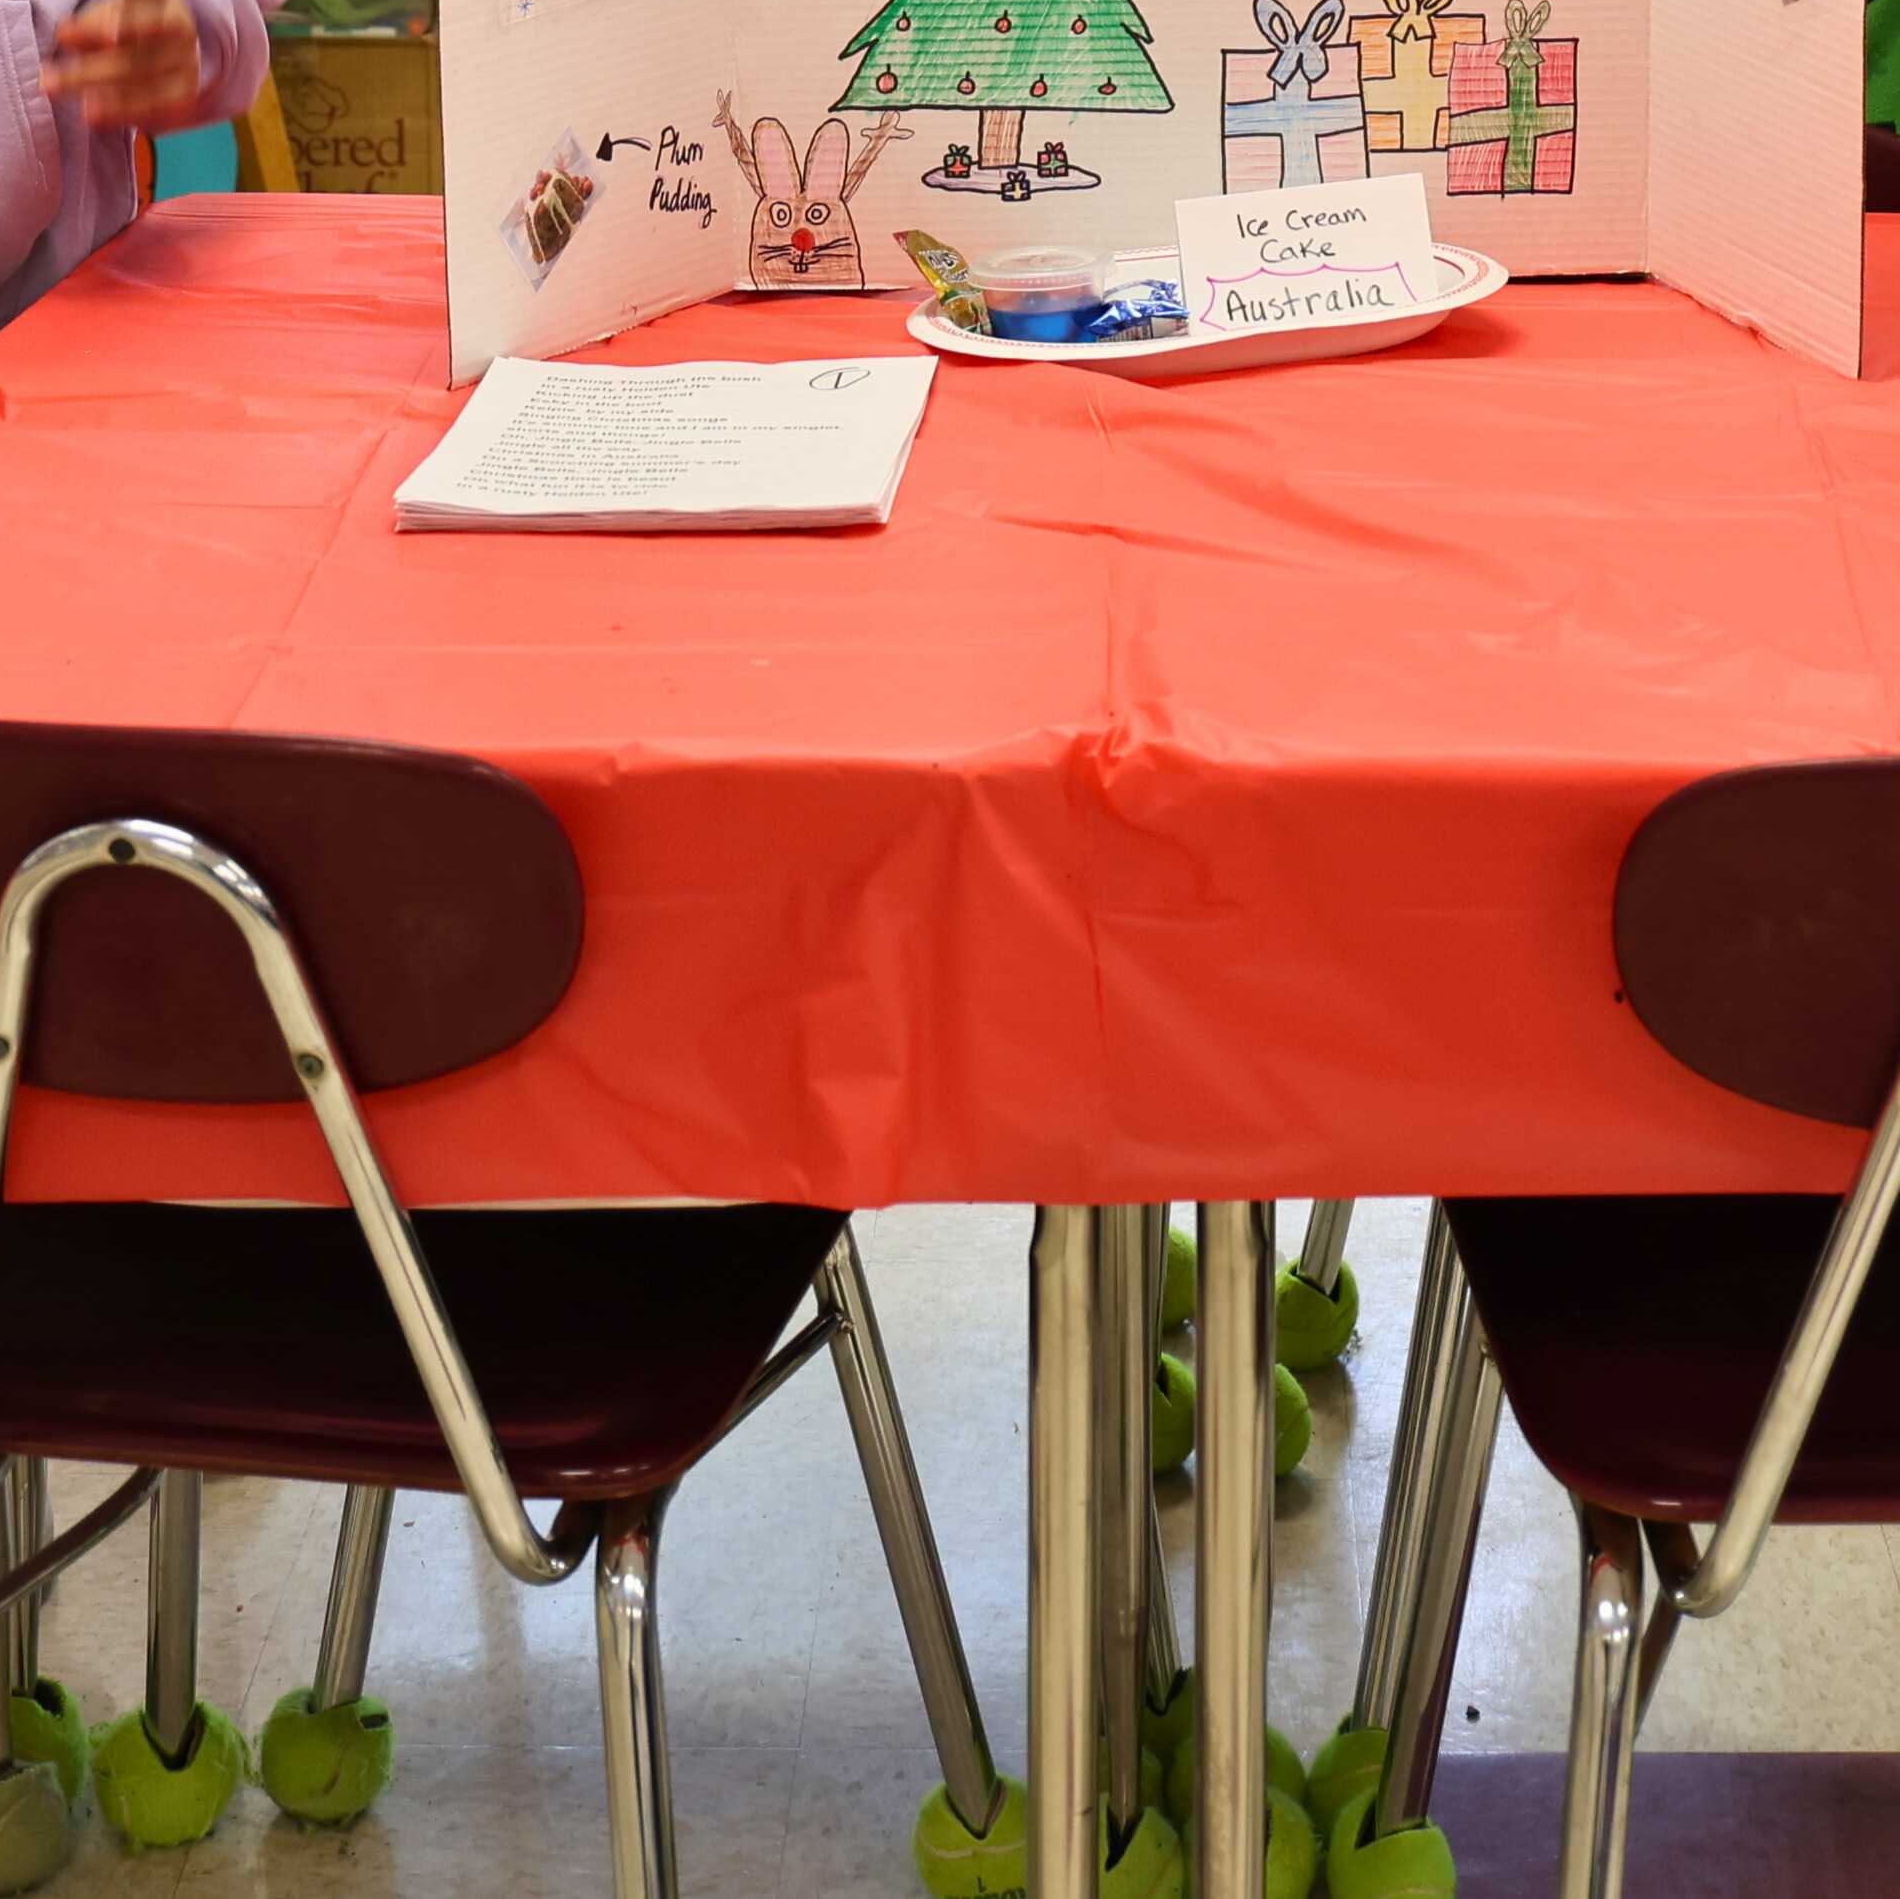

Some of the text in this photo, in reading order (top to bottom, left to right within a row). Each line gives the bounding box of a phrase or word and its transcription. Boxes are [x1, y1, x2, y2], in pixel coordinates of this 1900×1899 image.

[655, 125, 704, 171] Plum
[650, 178, 717, 229] Pudding
[1237, 206, 1367, 239] Ice Cream
[1226, 279, 1395, 324] Australia
